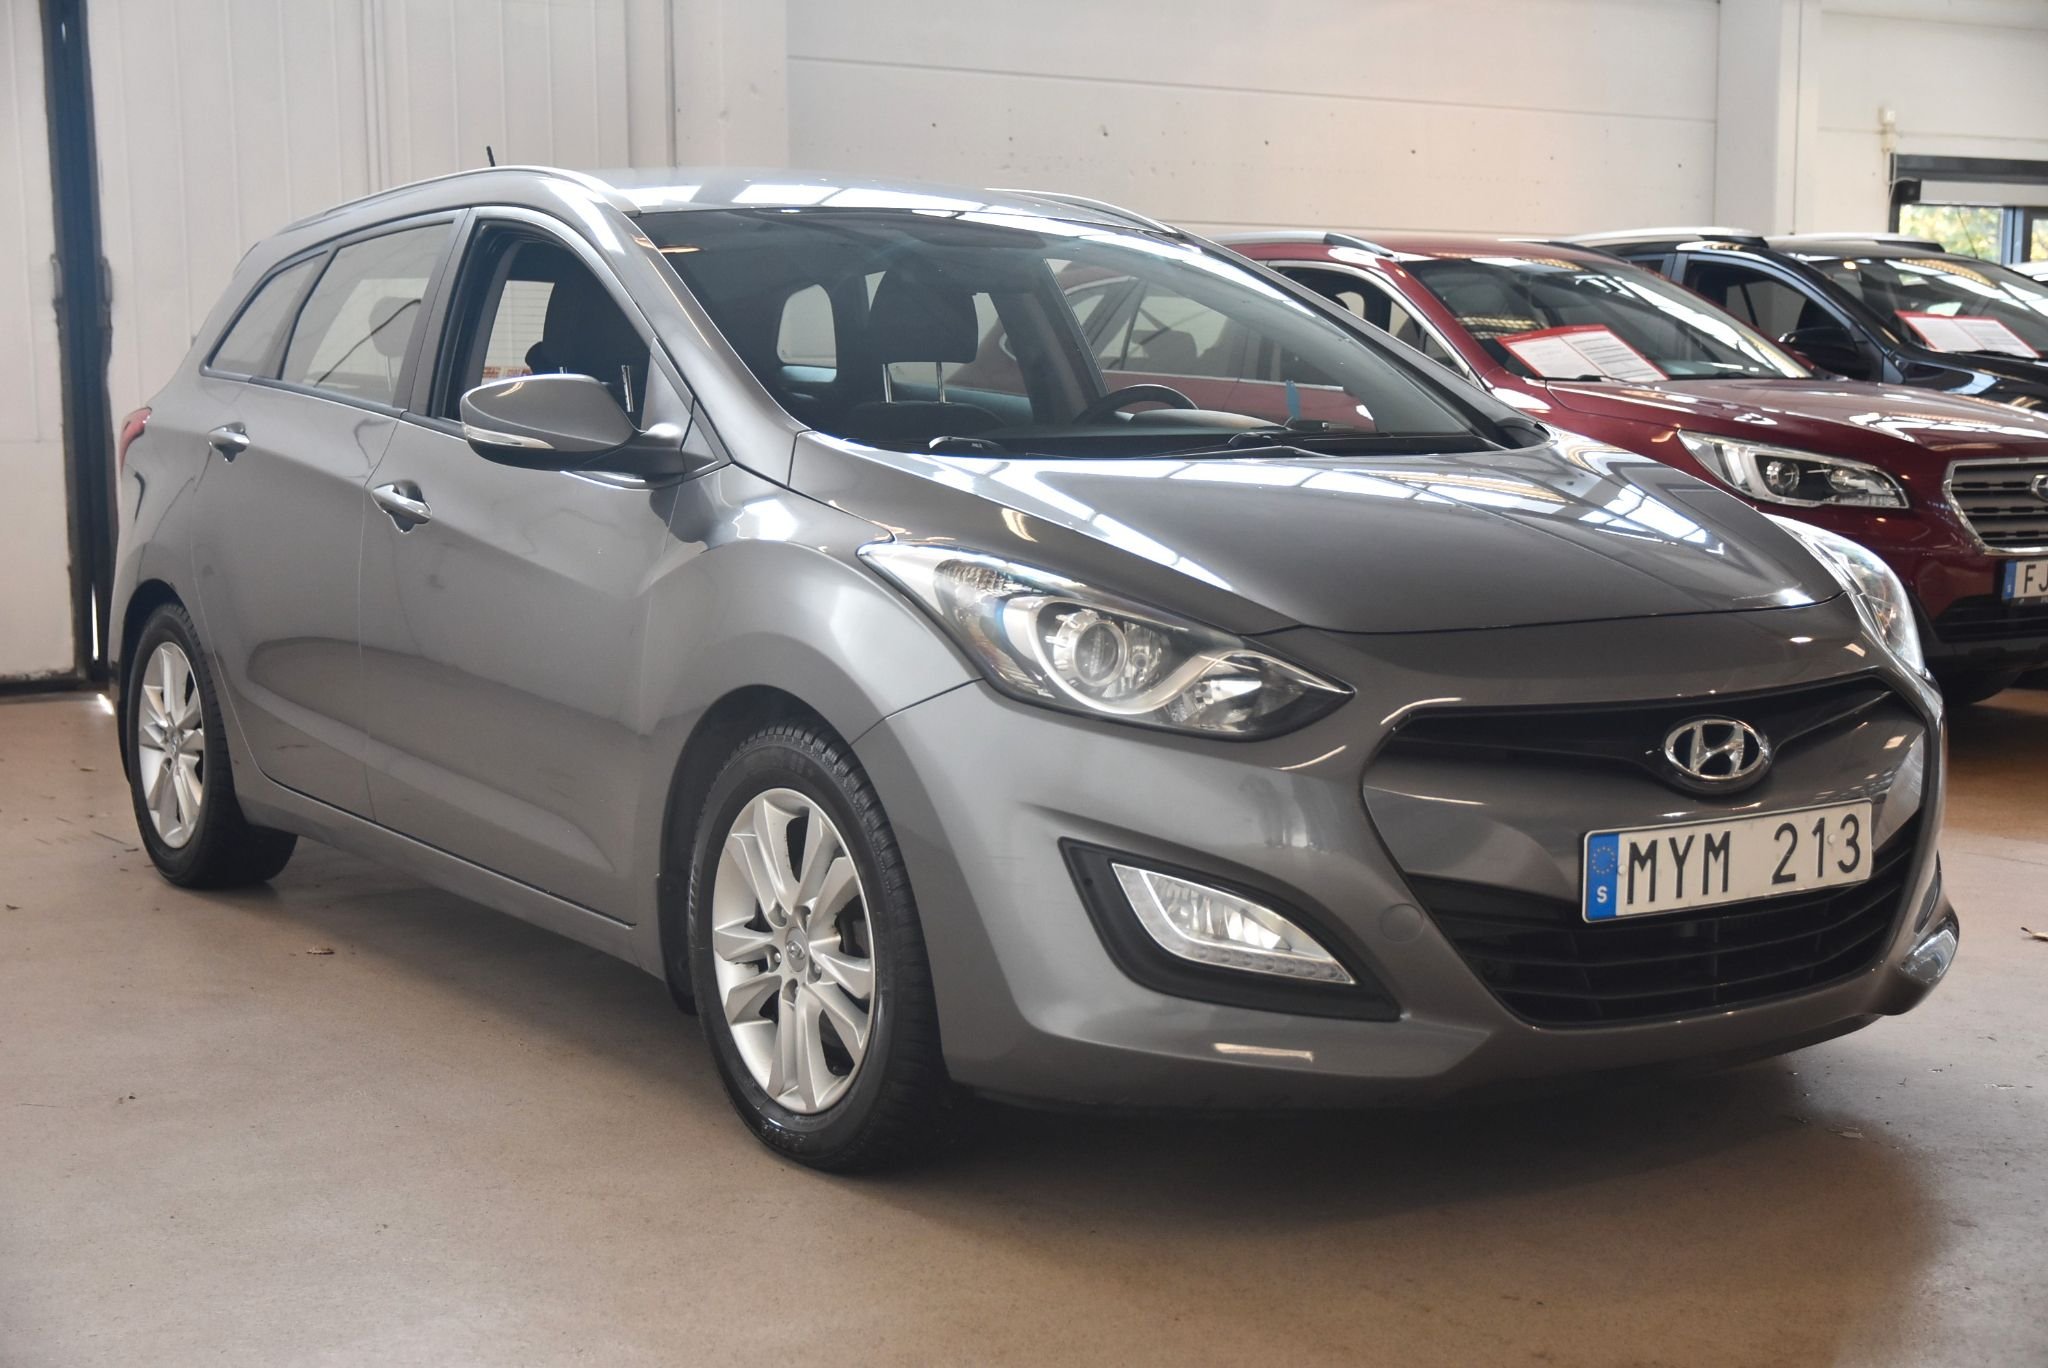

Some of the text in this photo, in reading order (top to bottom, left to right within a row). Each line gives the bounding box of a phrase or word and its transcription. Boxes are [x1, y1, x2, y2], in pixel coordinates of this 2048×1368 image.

[1627, 813, 1861, 905] MYM 213
[1596, 885, 1608, 904] S
